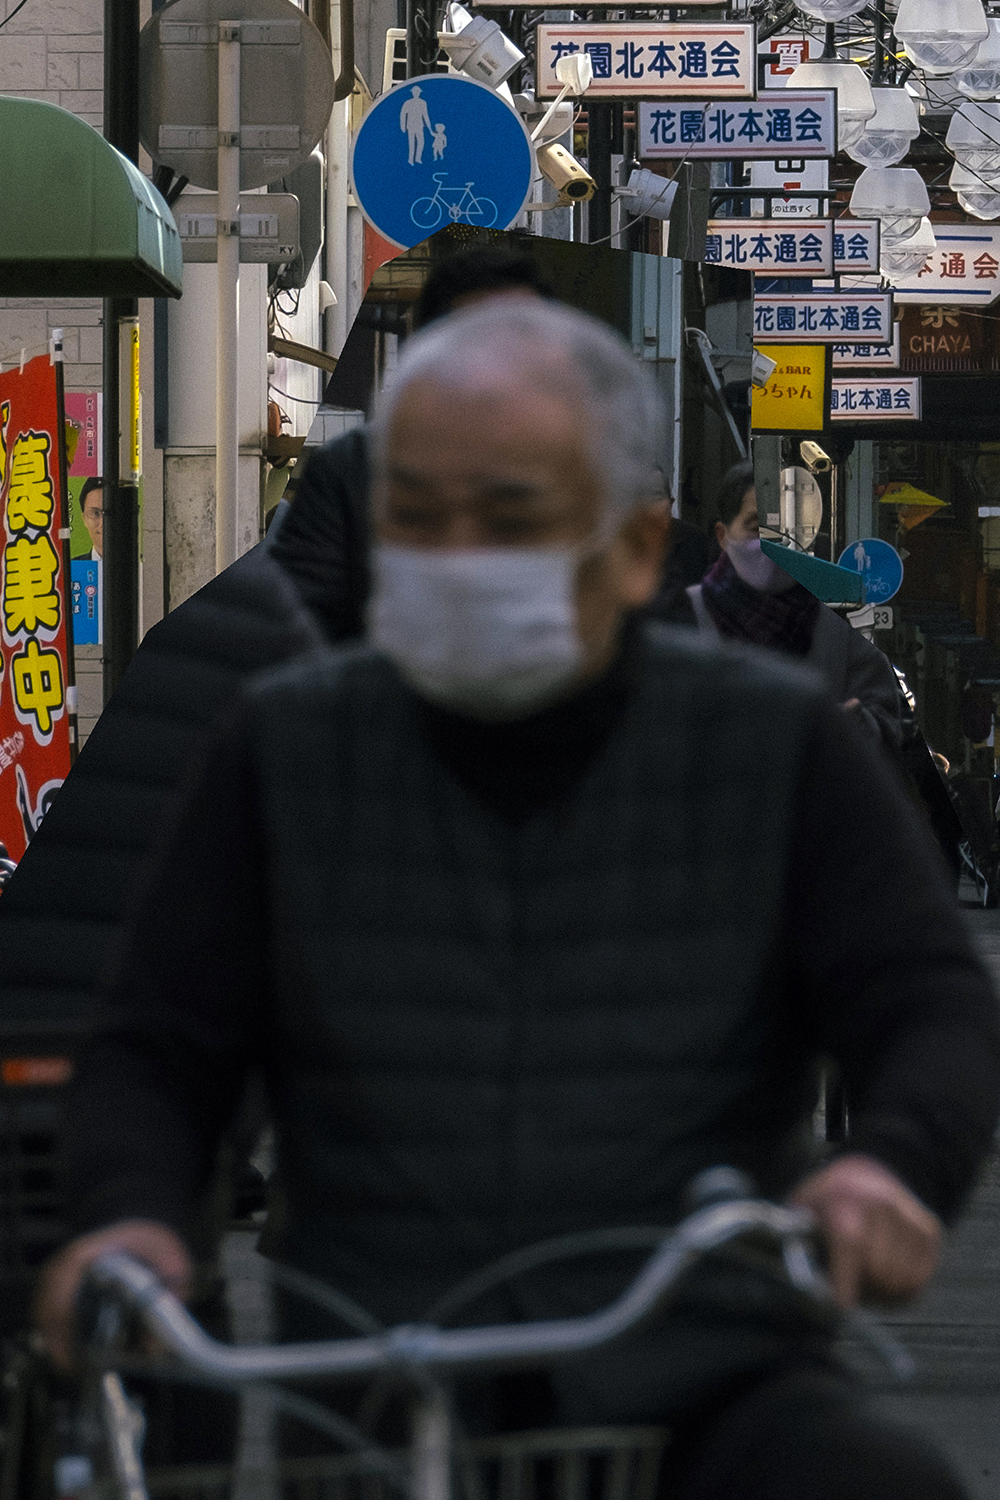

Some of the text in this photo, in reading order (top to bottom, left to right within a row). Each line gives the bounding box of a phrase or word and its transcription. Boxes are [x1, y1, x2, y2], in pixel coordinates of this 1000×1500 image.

[776, 43, 804, 72] 質
[649, 106, 825, 146] 花園北本通会
[755, 304, 883, 333] 花園北本通会
[909, 335, 971, 354] CHAYA
[785, 365, 811, 375] BAR
